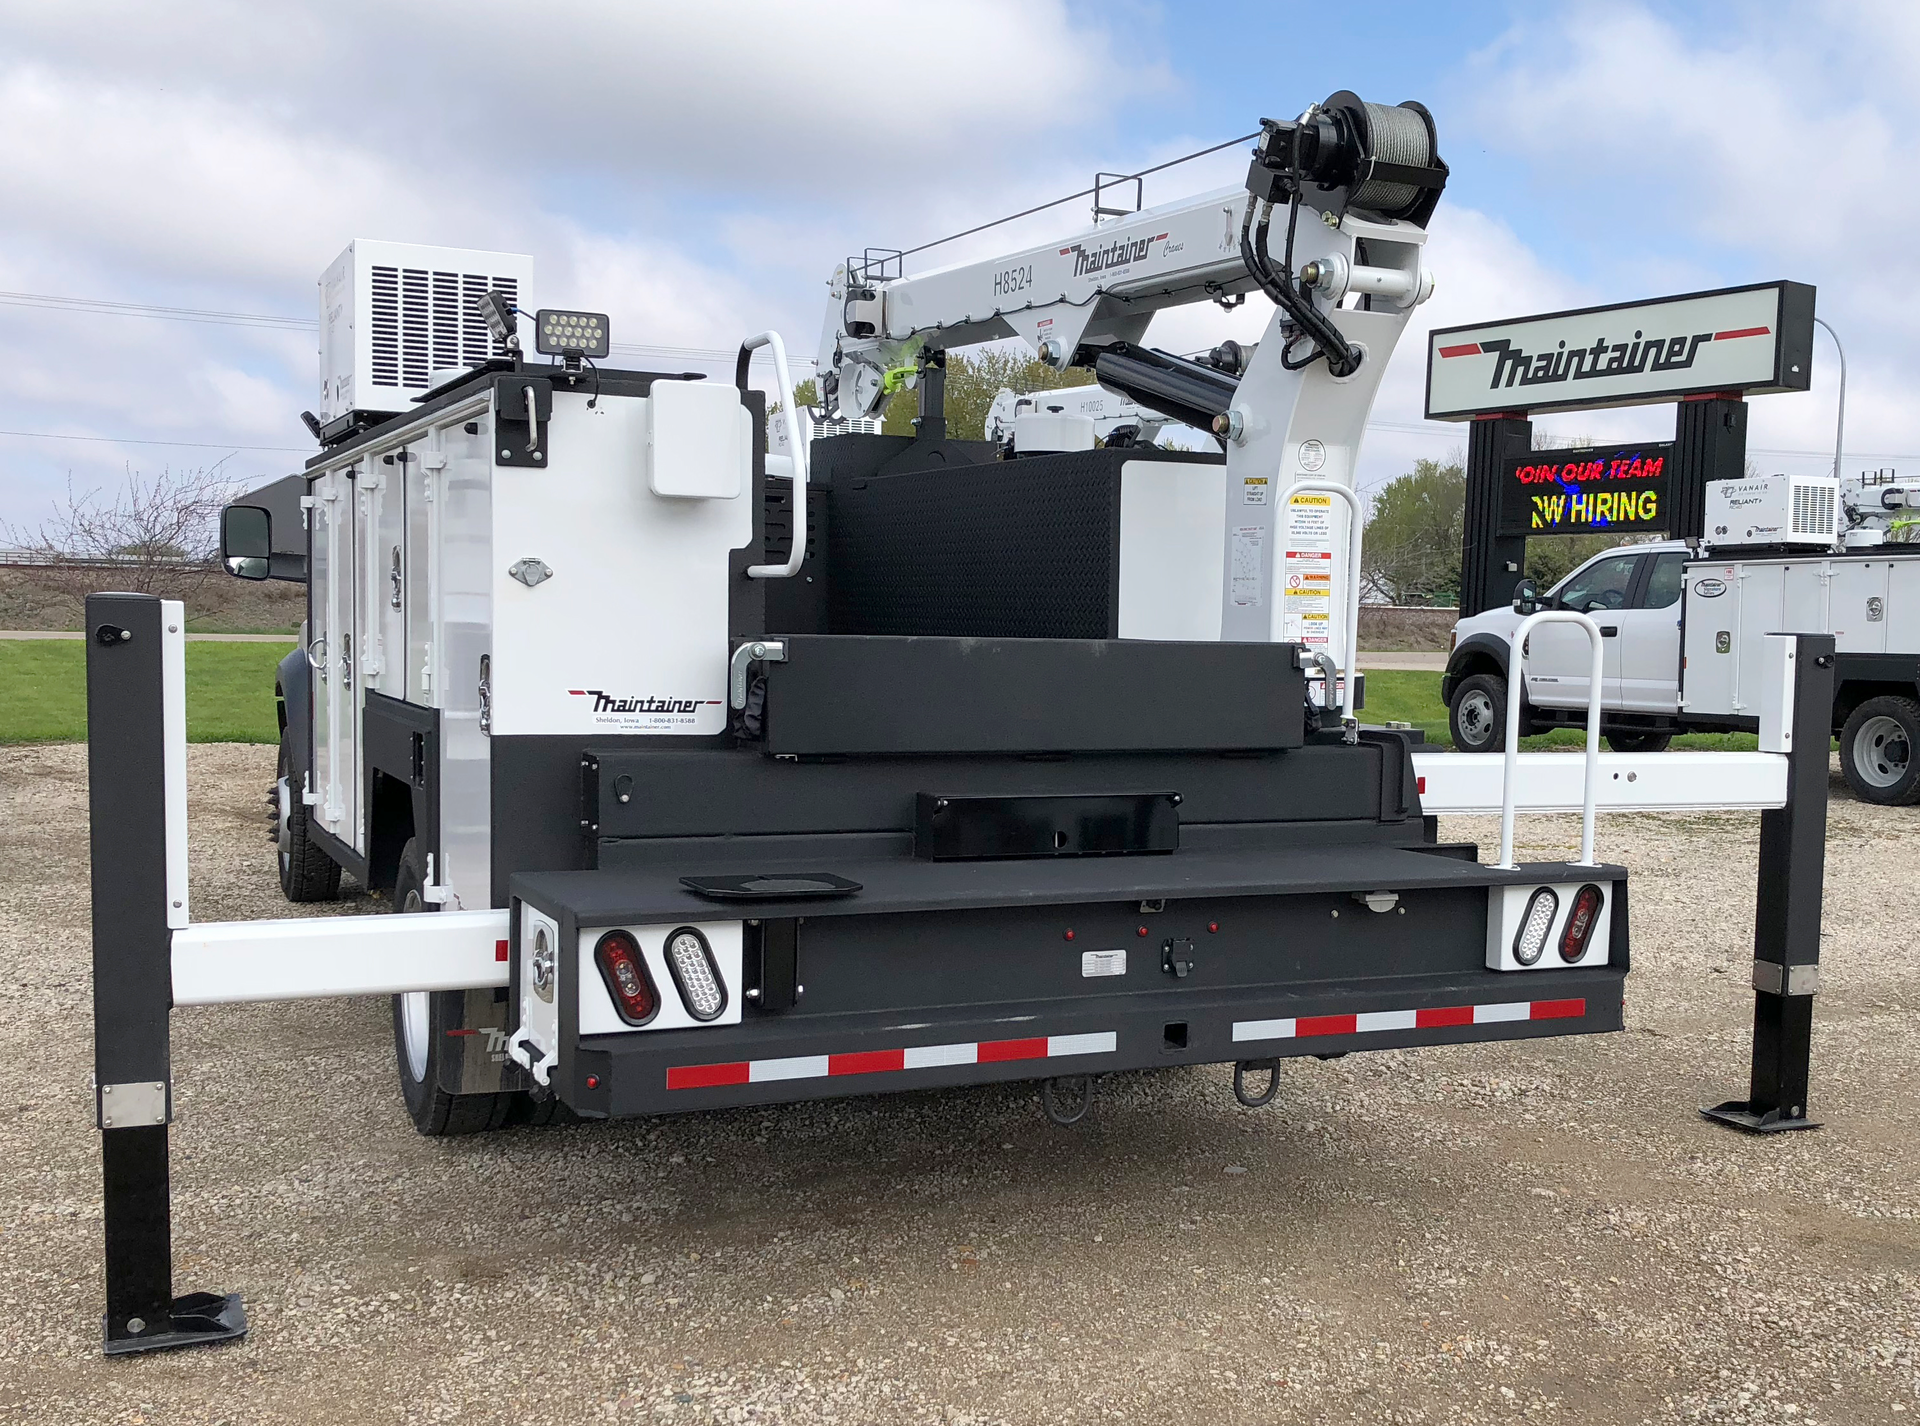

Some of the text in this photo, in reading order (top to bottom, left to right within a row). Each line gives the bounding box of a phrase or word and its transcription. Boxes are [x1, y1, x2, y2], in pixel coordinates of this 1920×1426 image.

[1070, 236, 1155, 277] Maintainer
[1163, 241, 1184, 258] Cranes
[993, 264, 1033, 297] H8524
[1479, 330, 1713, 390] Maintainer
[1080, 400, 1104, 413] H10025
[1561, 461, 1604, 483] OUR
[1609, 457, 1665, 480] TEAM
[1738, 483, 1769, 492] VANAIR
[1570, 490, 1658, 523] HIRING
[1729, 498, 1759, 506] RELIANT
[586, 690, 706, 714] Maintainer
[595, 716, 622, 725] Sheldon,
